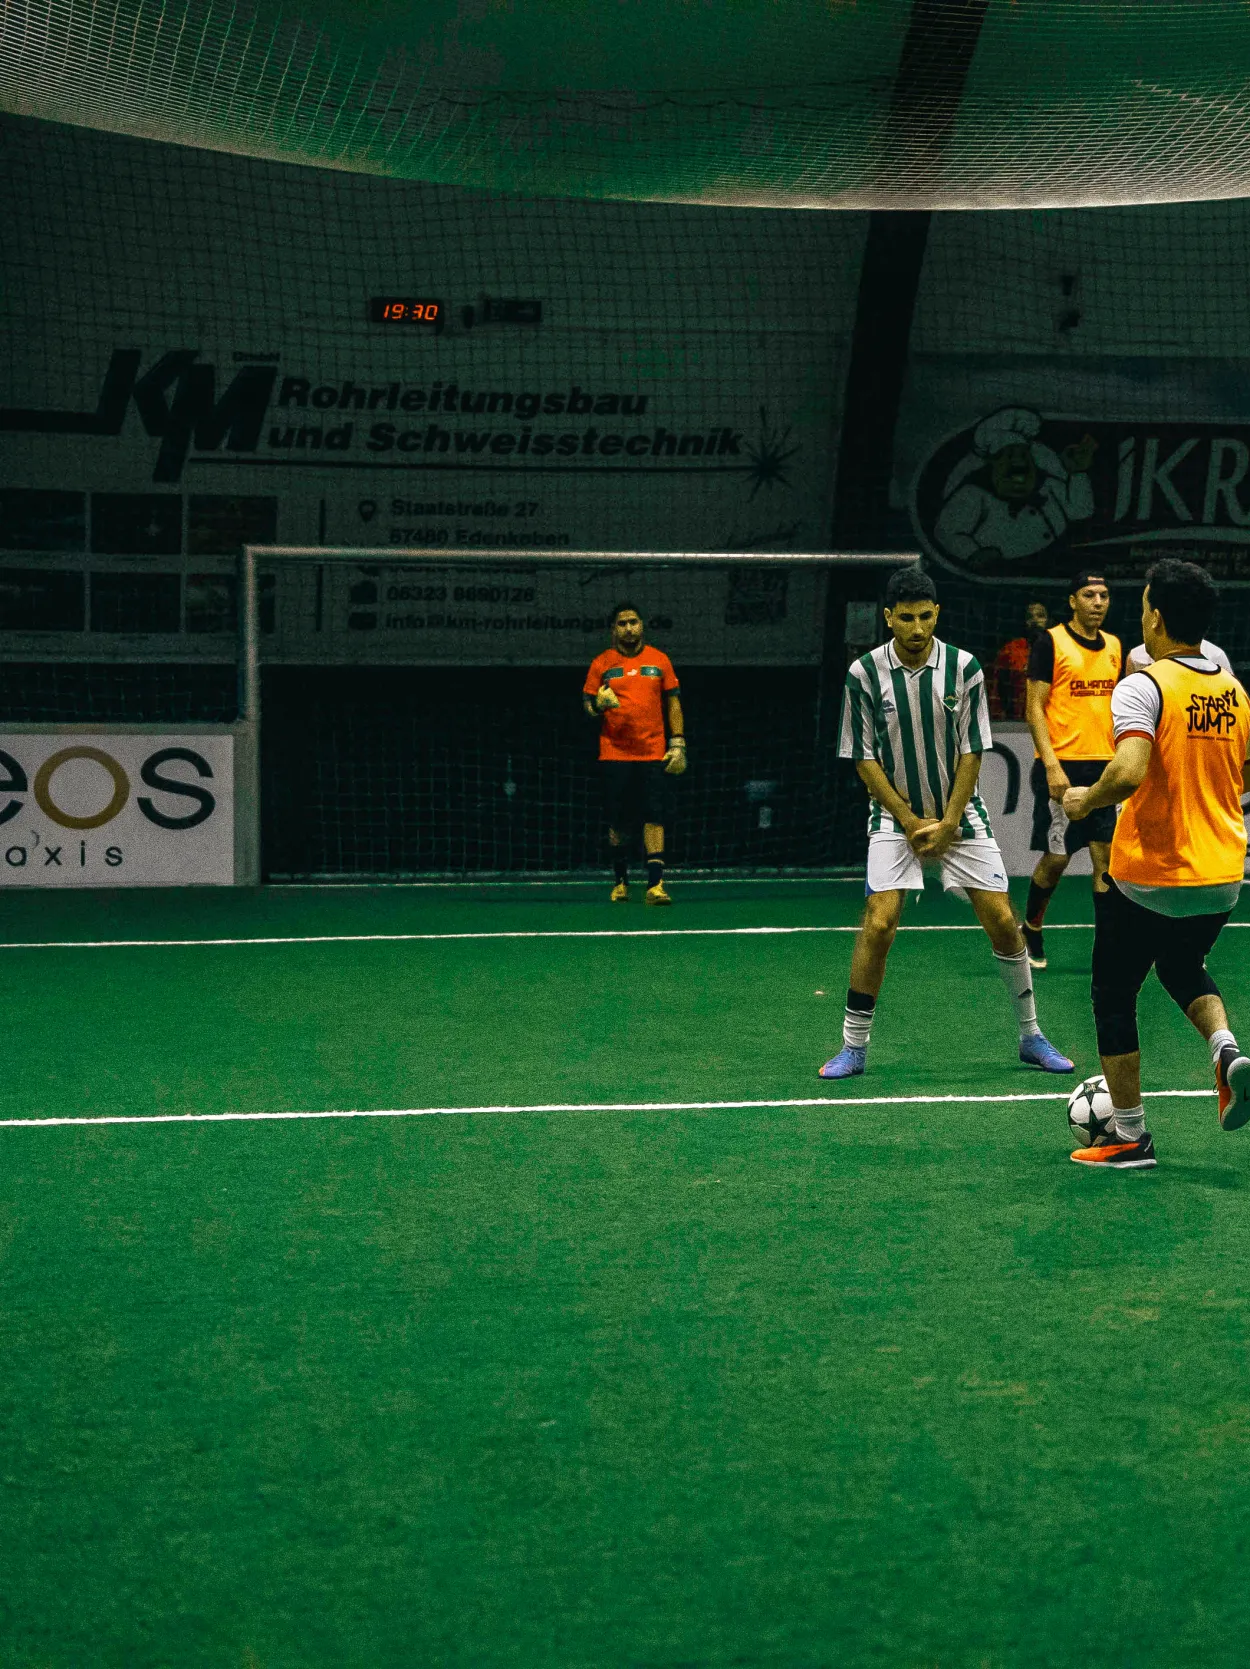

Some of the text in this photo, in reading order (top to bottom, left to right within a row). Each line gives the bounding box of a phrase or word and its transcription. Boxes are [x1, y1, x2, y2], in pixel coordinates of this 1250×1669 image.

[383, 303, 438, 321] 19:30
[277, 376, 646, 419] Rohrleitungsbau
[267, 422, 743, 457] und Schweisstechnik
[514, 502, 539, 517] 27
